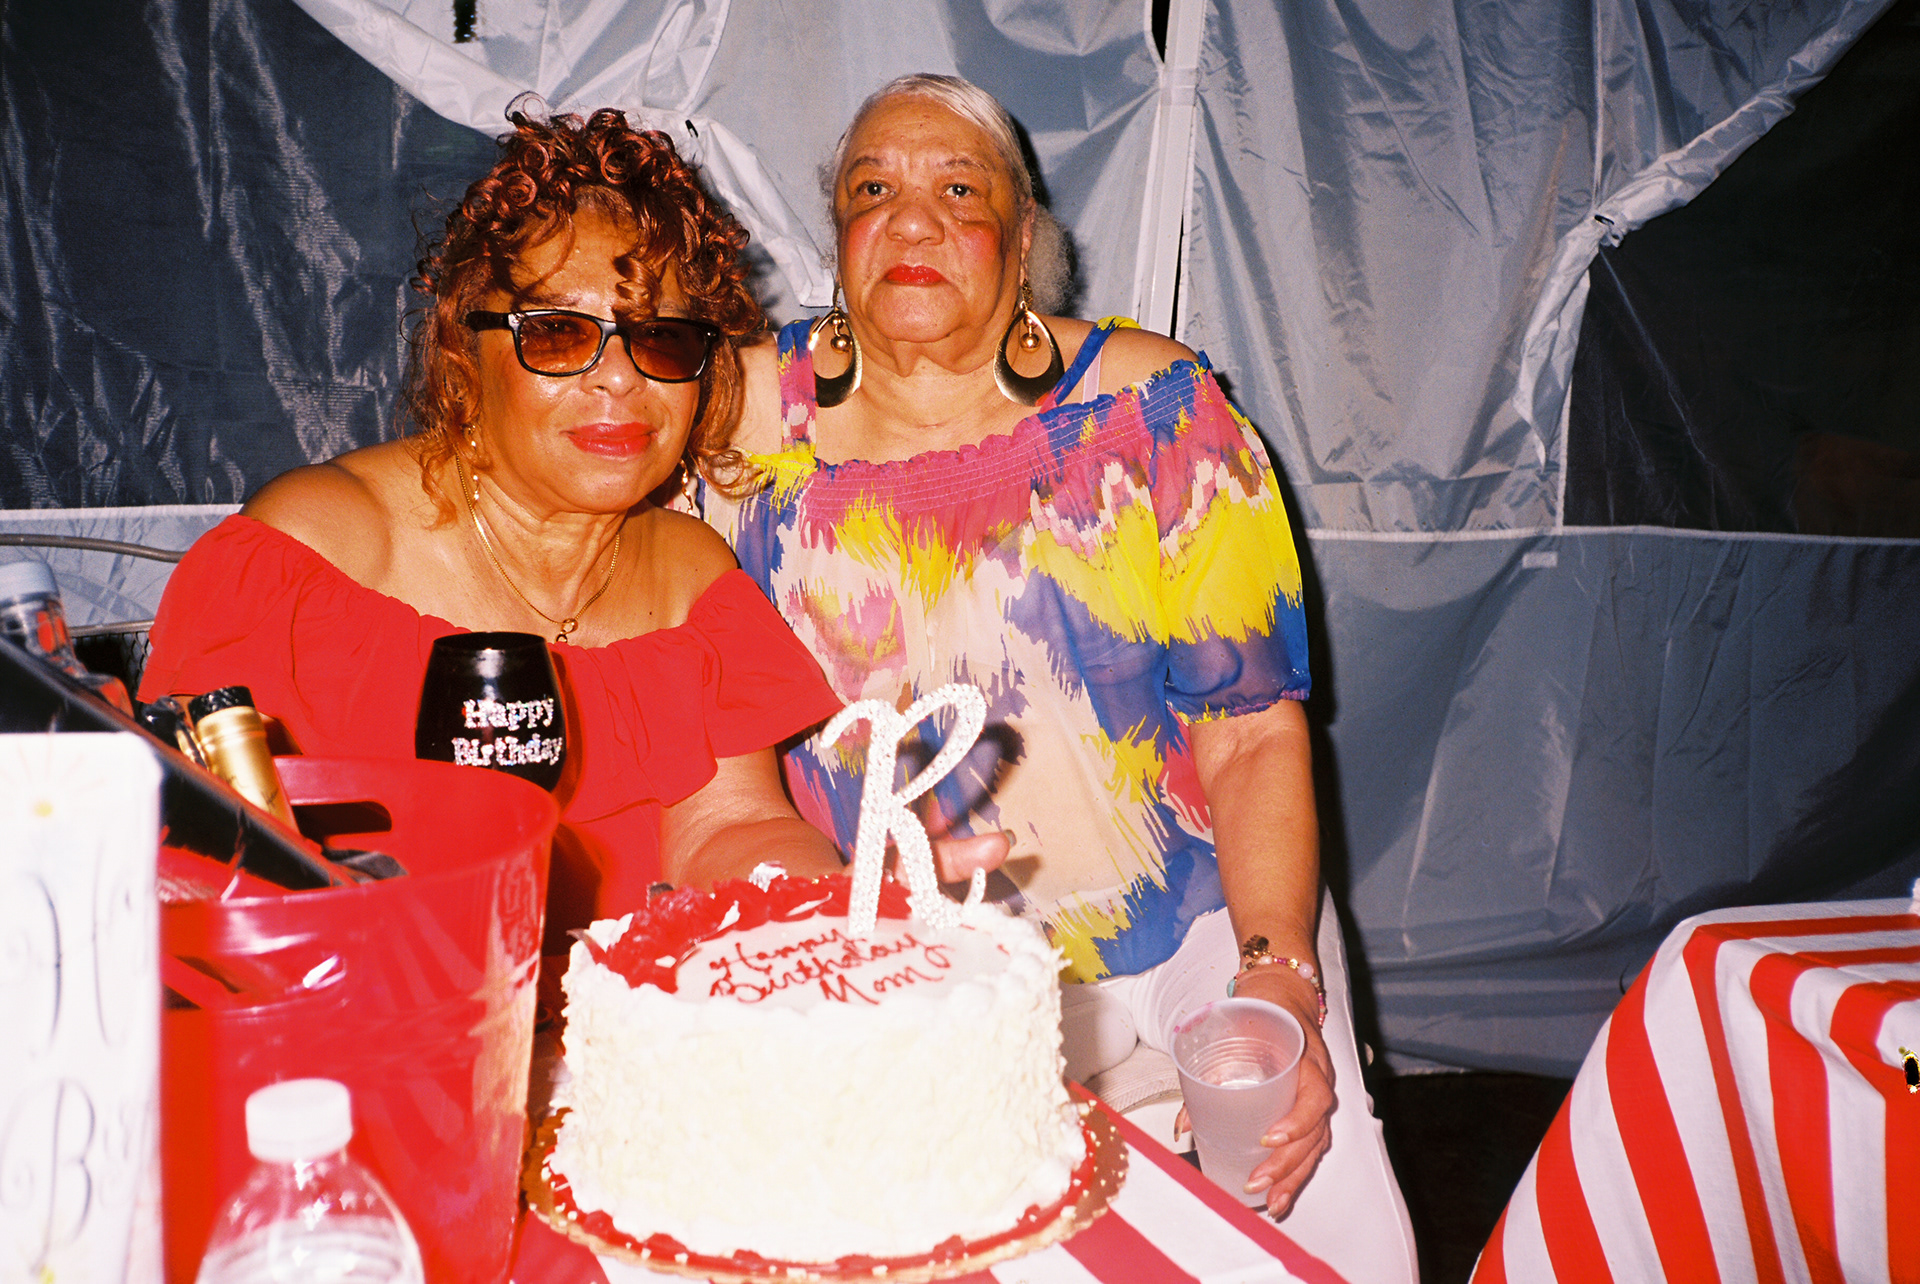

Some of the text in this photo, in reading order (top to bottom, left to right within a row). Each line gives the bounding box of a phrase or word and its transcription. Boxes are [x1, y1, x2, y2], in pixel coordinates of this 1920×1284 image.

[463, 698, 554, 731] Happy
[451, 732, 563, 767] Birthday
[709, 928, 868, 980] Happy
[709, 932, 955, 1003] Birthday
[819, 966, 945, 1006] Mom
